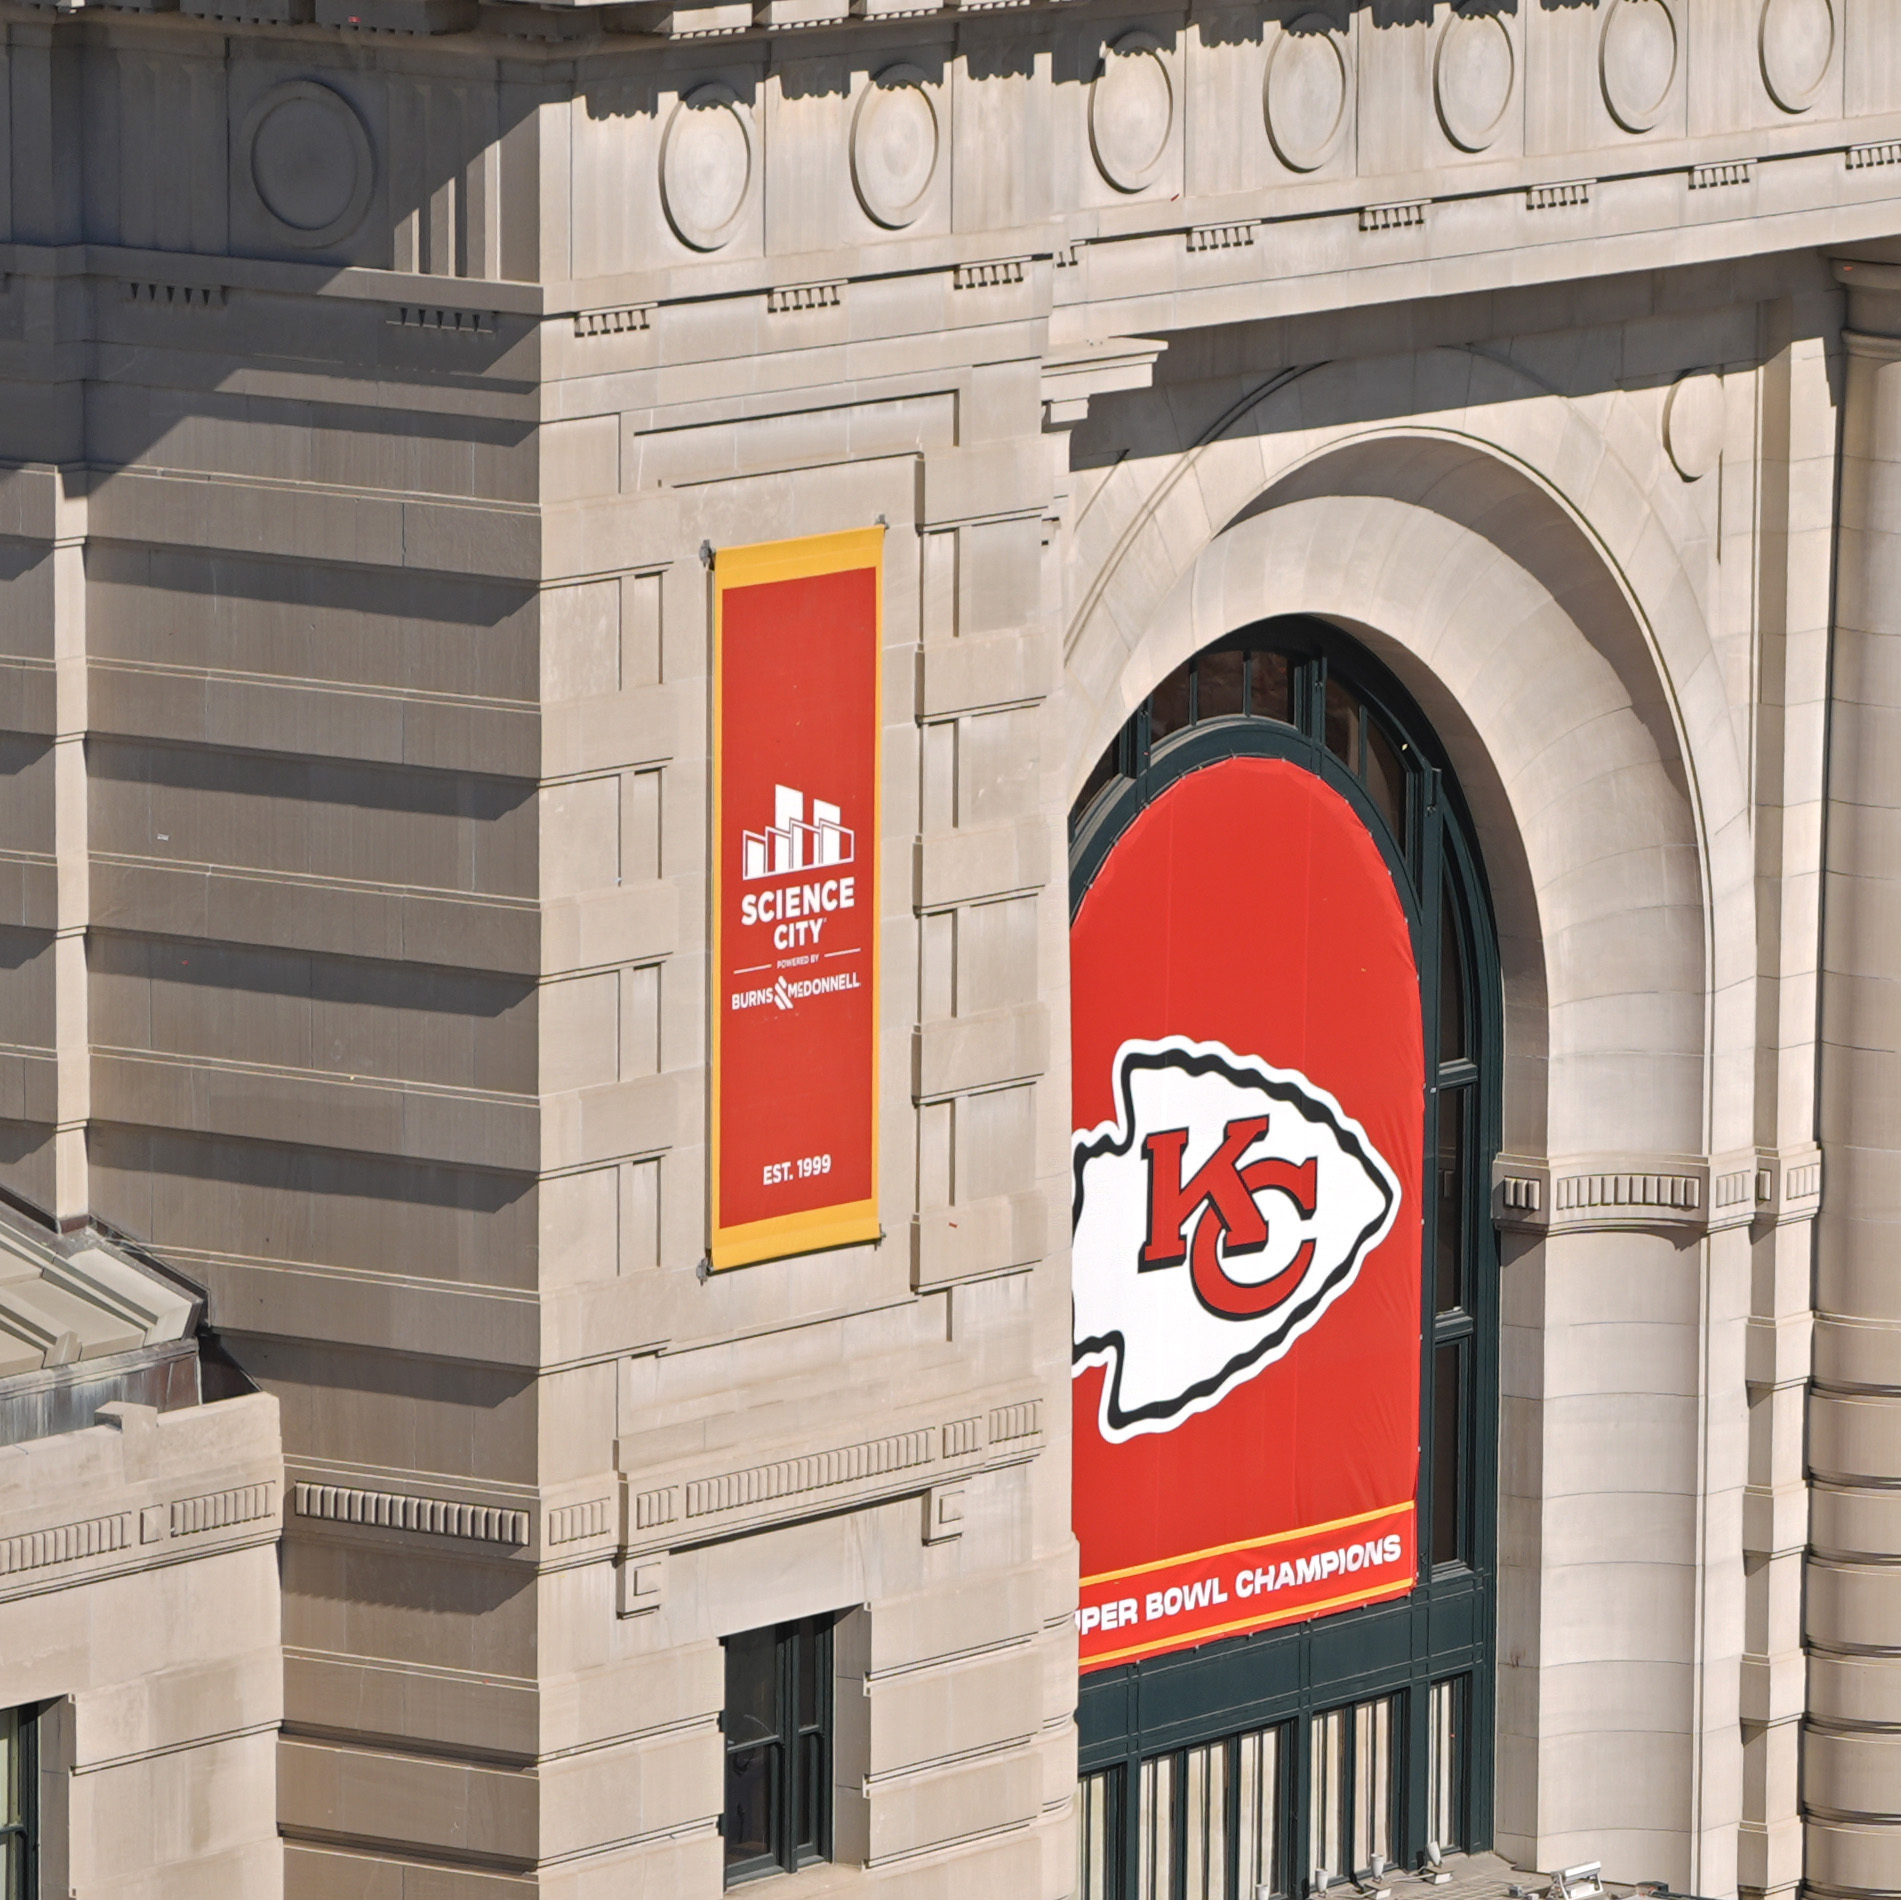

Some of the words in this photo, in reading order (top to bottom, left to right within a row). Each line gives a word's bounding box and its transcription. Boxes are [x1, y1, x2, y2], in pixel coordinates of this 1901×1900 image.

[741, 877, 855, 926] SCIENCE
[773, 917, 823, 950] CITY
[776, 955, 810, 969] POWERED
[810, 954, 820, 964] BY
[731, 987, 774, 1010] BURNS
[762, 1159, 793, 1186] EST.
[797, 1154, 832, 1181] 1999
[1145, 1578, 1228, 1622] BOWL
[1235, 1533, 1402, 1598] CHAMPIONS
